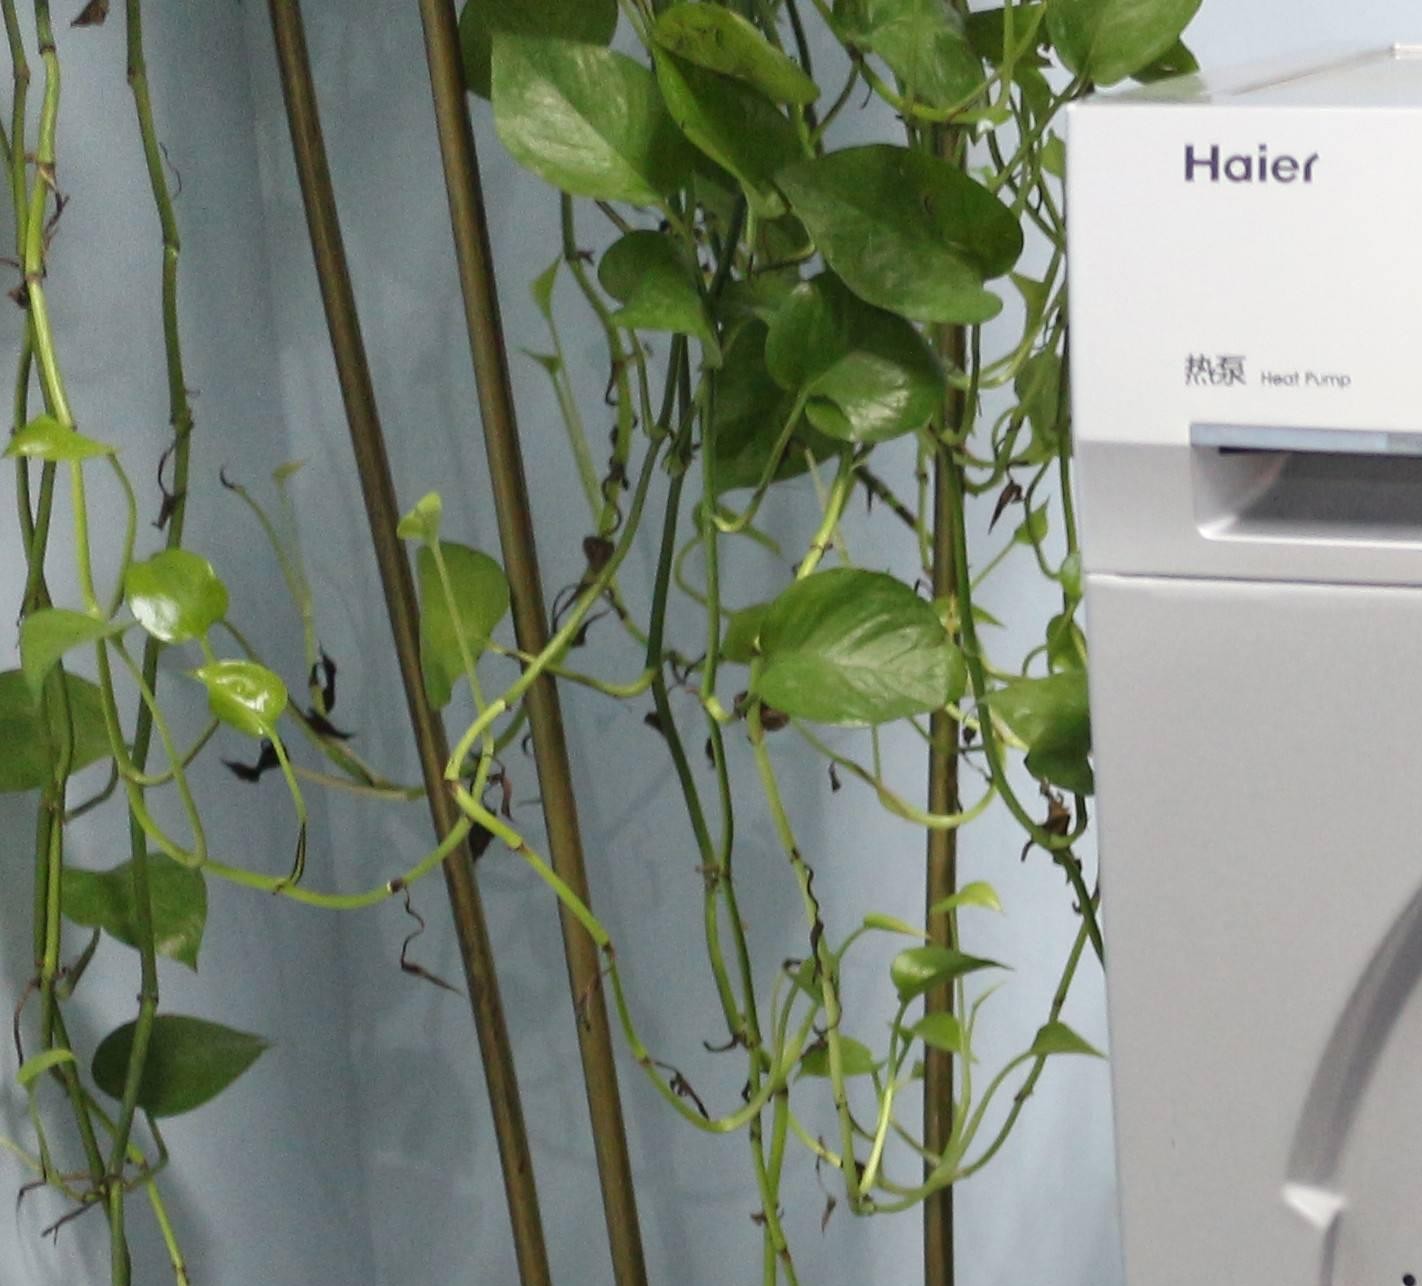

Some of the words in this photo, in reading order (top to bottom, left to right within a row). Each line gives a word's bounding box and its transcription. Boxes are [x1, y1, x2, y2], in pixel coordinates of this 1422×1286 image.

[1184, 143, 1319, 184] Haier
[1185, 353, 1247, 386] 热泵
[1260, 371, 1300, 387] Heat
[1304, 371, 1352, 389] Pump
